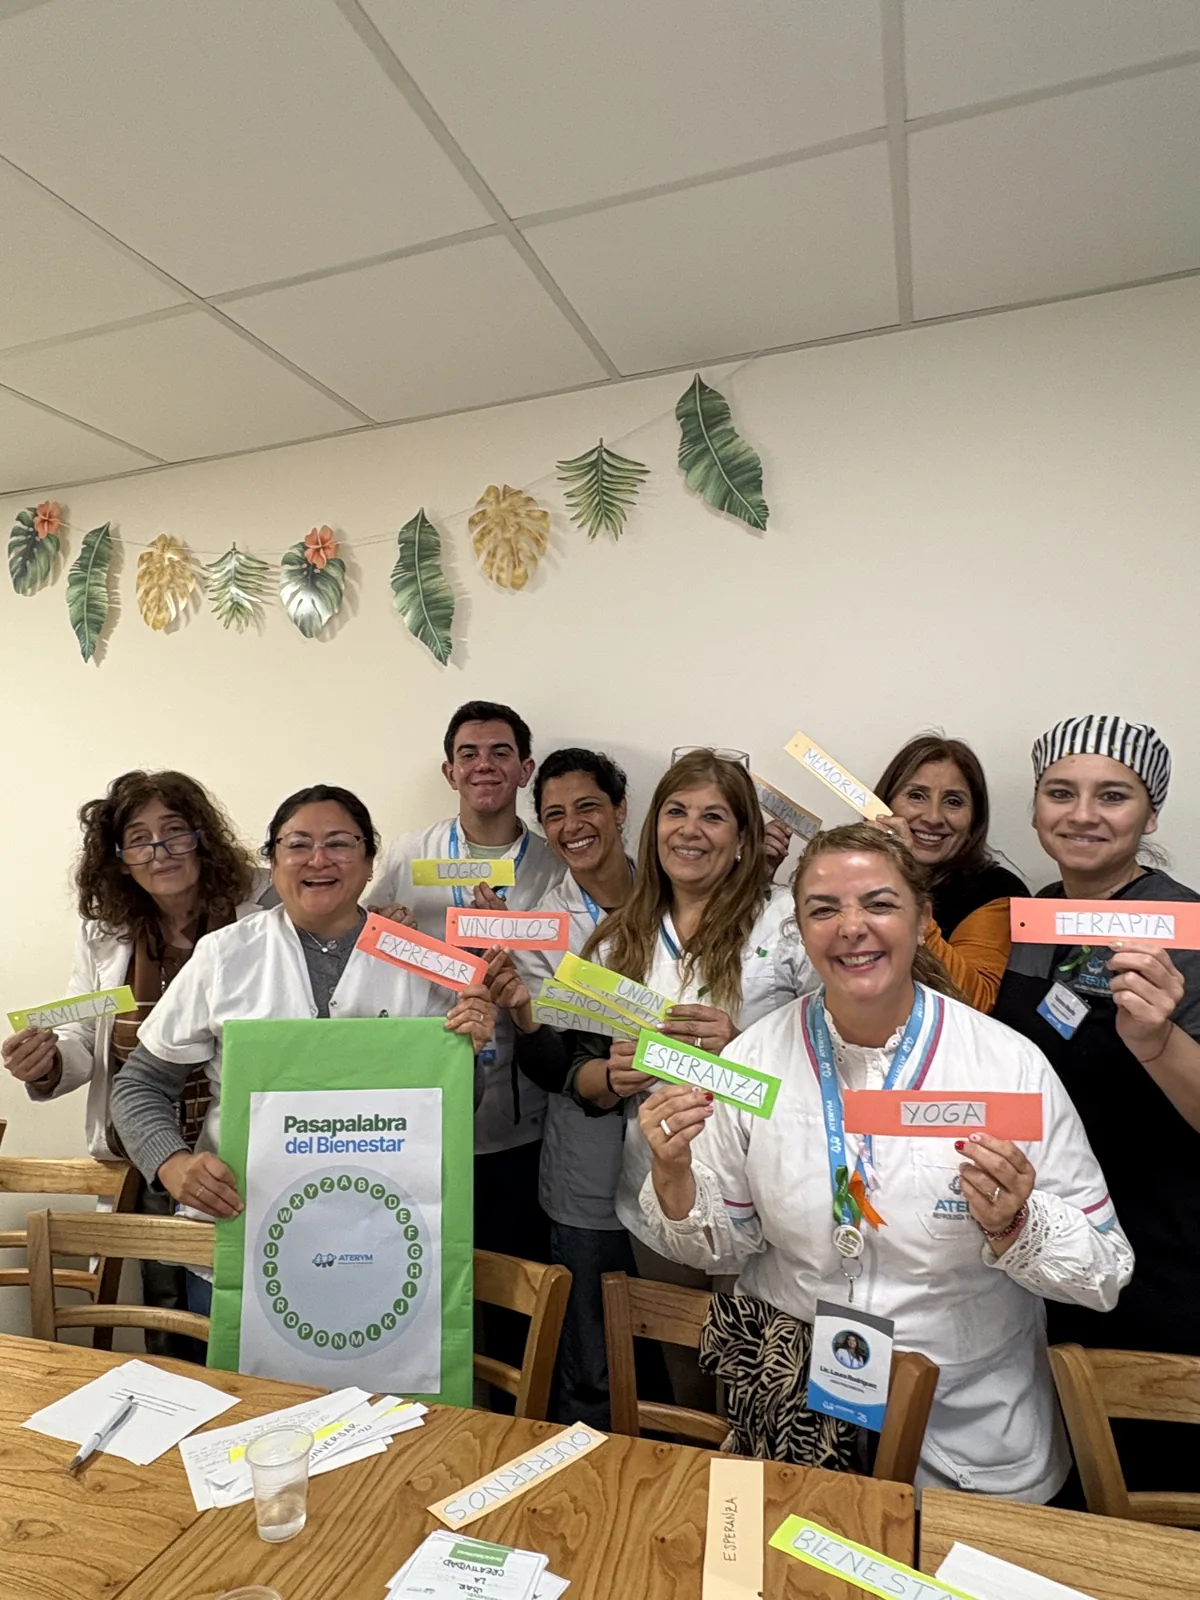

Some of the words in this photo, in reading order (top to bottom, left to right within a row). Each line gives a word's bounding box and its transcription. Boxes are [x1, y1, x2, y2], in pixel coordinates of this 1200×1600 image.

[803, 747, 868, 808] MEMORIA
[437, 861, 493, 879] LOGRO
[379, 934, 470, 983] EXPRESAR
[27, 995, 119, 1027] FAMILIA
[643, 1043, 764, 1109] ESPERANZA
[903, 1103, 983, 1125] YOGA
[283, 1114, 407, 1137] Pasapalabra
[285, 1136, 313, 1154] del
[317, 1135, 405, 1154] Bienestar
[323, 1179, 332, 1191] Z
[339, 1176, 349, 1188] A
[357, 1179, 366, 1191] B
[306, 1185, 316, 1197] Y
[372, 1185, 383, 1197] C
[292, 1196, 302, 1207] X
[388, 1196, 398, 1208] D
[934, 1199, 971, 1213] ATE
[279, 1210, 291, 1221] W
[399, 1210, 408, 1222] E
[271, 1226, 281, 1238] V
[407, 1227, 416, 1239] F
[266, 1244, 276, 1257] U
[410, 1245, 420, 1258] G
[338, 1253, 373, 1262] ATERYM
[266, 1264, 275, 1276] T
[409, 1265, 420, 1277] H
[269, 1282, 278, 1294] S
[276, 1299, 286, 1311] R
[396, 1300, 405, 1313] J
[286, 1314, 297, 1326] Q
[384, 1315, 393, 1328] K
[301, 1325, 310, 1337] P
[370, 1326, 378, 1339] L
[316, 1332, 327, 1345] O
[334, 1335, 344, 1347] N
[350, 1333, 363, 1346] M
[444, 1430, 593, 1521] QUERERNOS
[722, 1496, 738, 1563] ESPERANZA
[474, 1577, 487, 1585] LA
